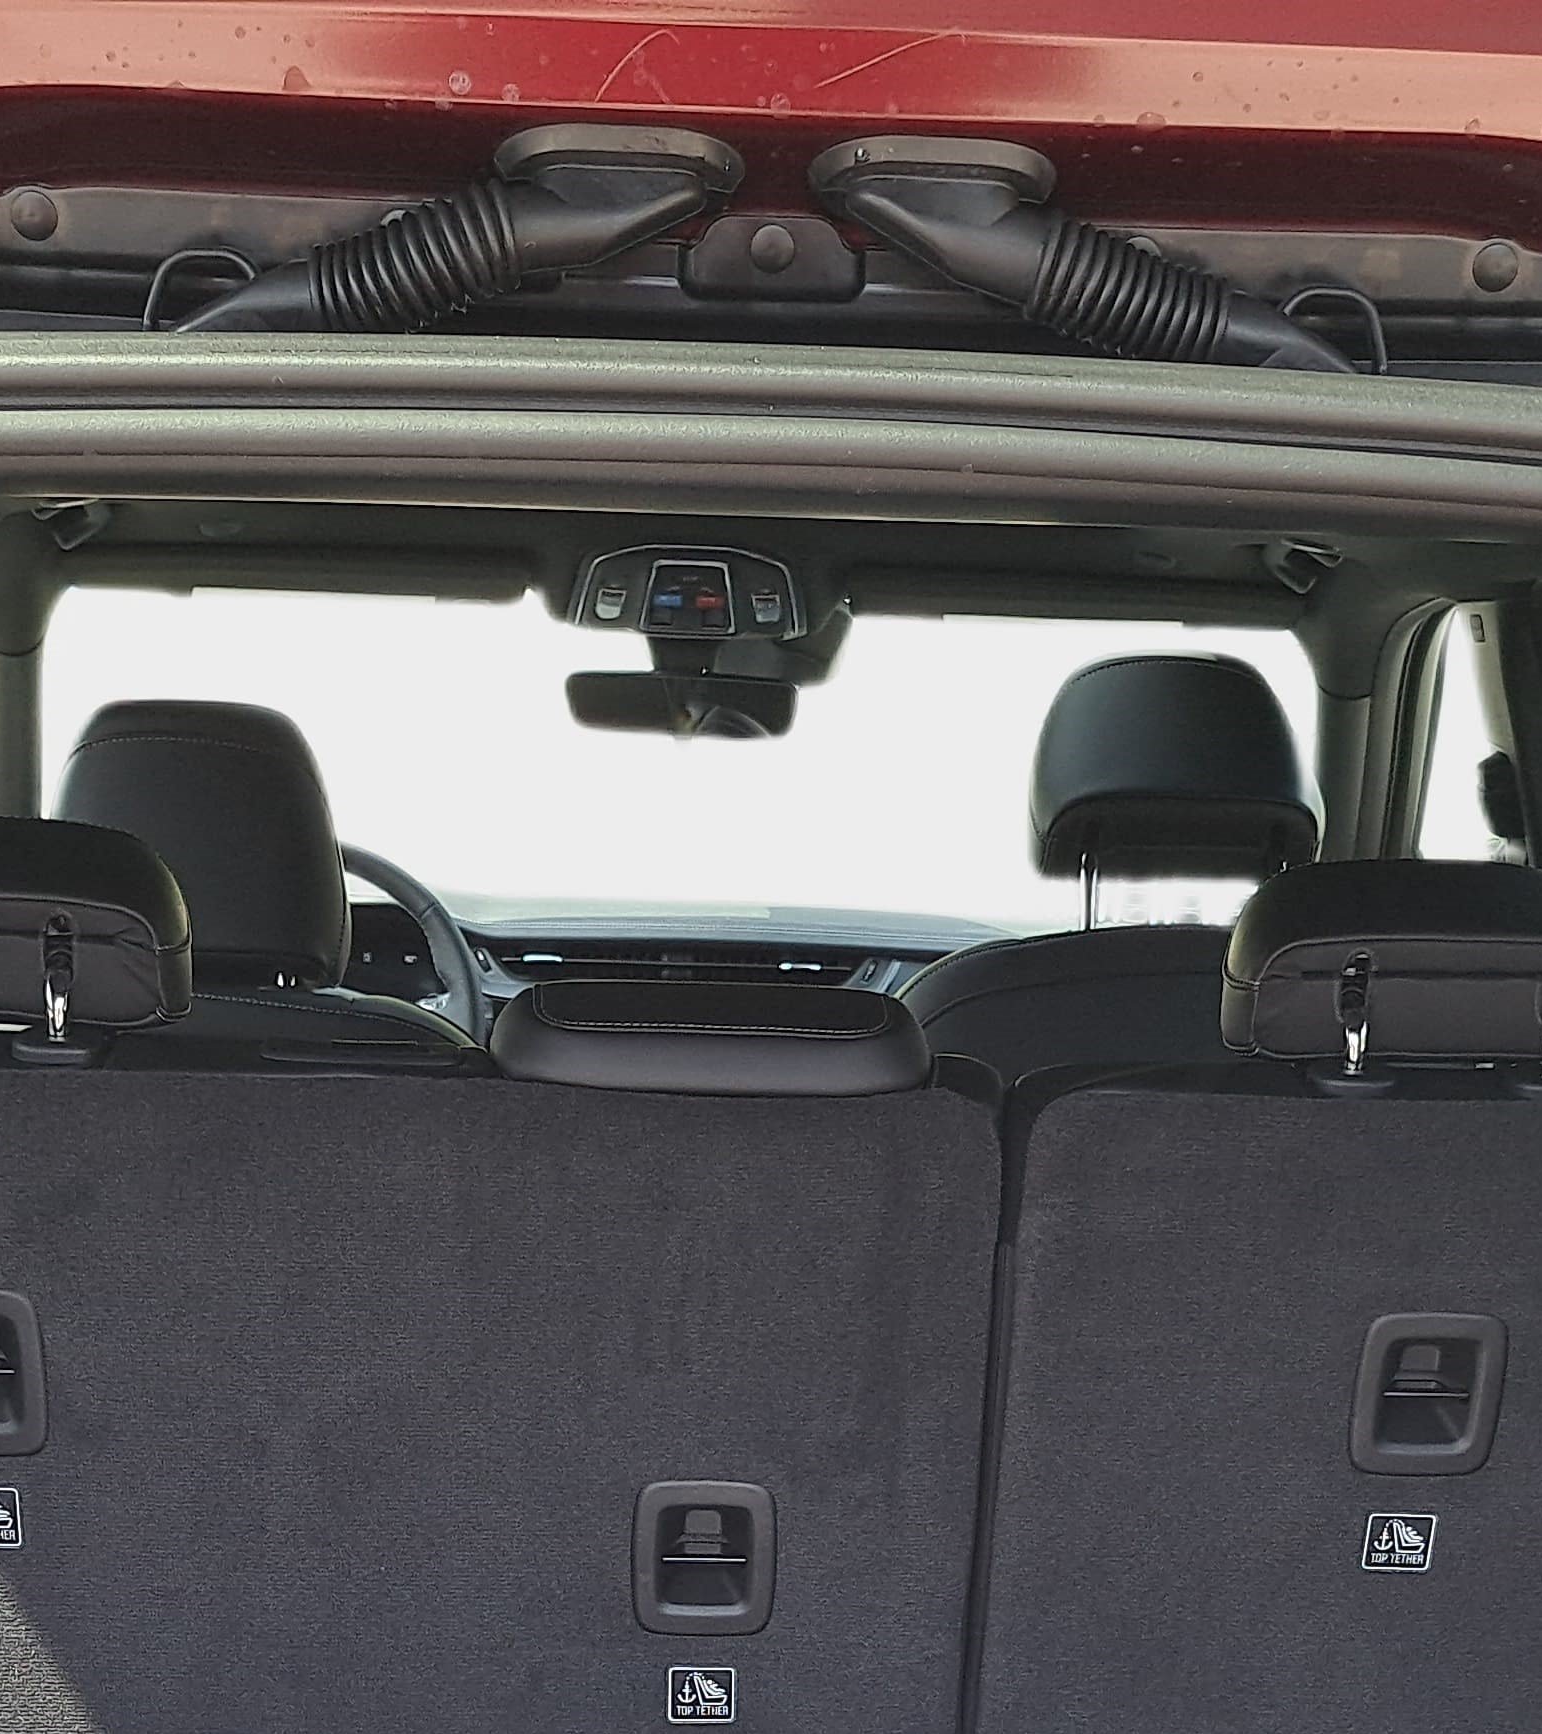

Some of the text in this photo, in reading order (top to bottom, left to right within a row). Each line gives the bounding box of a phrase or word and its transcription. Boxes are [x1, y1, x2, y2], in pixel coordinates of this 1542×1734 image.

[1370, 1553, 1424, 1565] TOP TETHER
[676, 1705, 729, 1716] TOP TETHER
